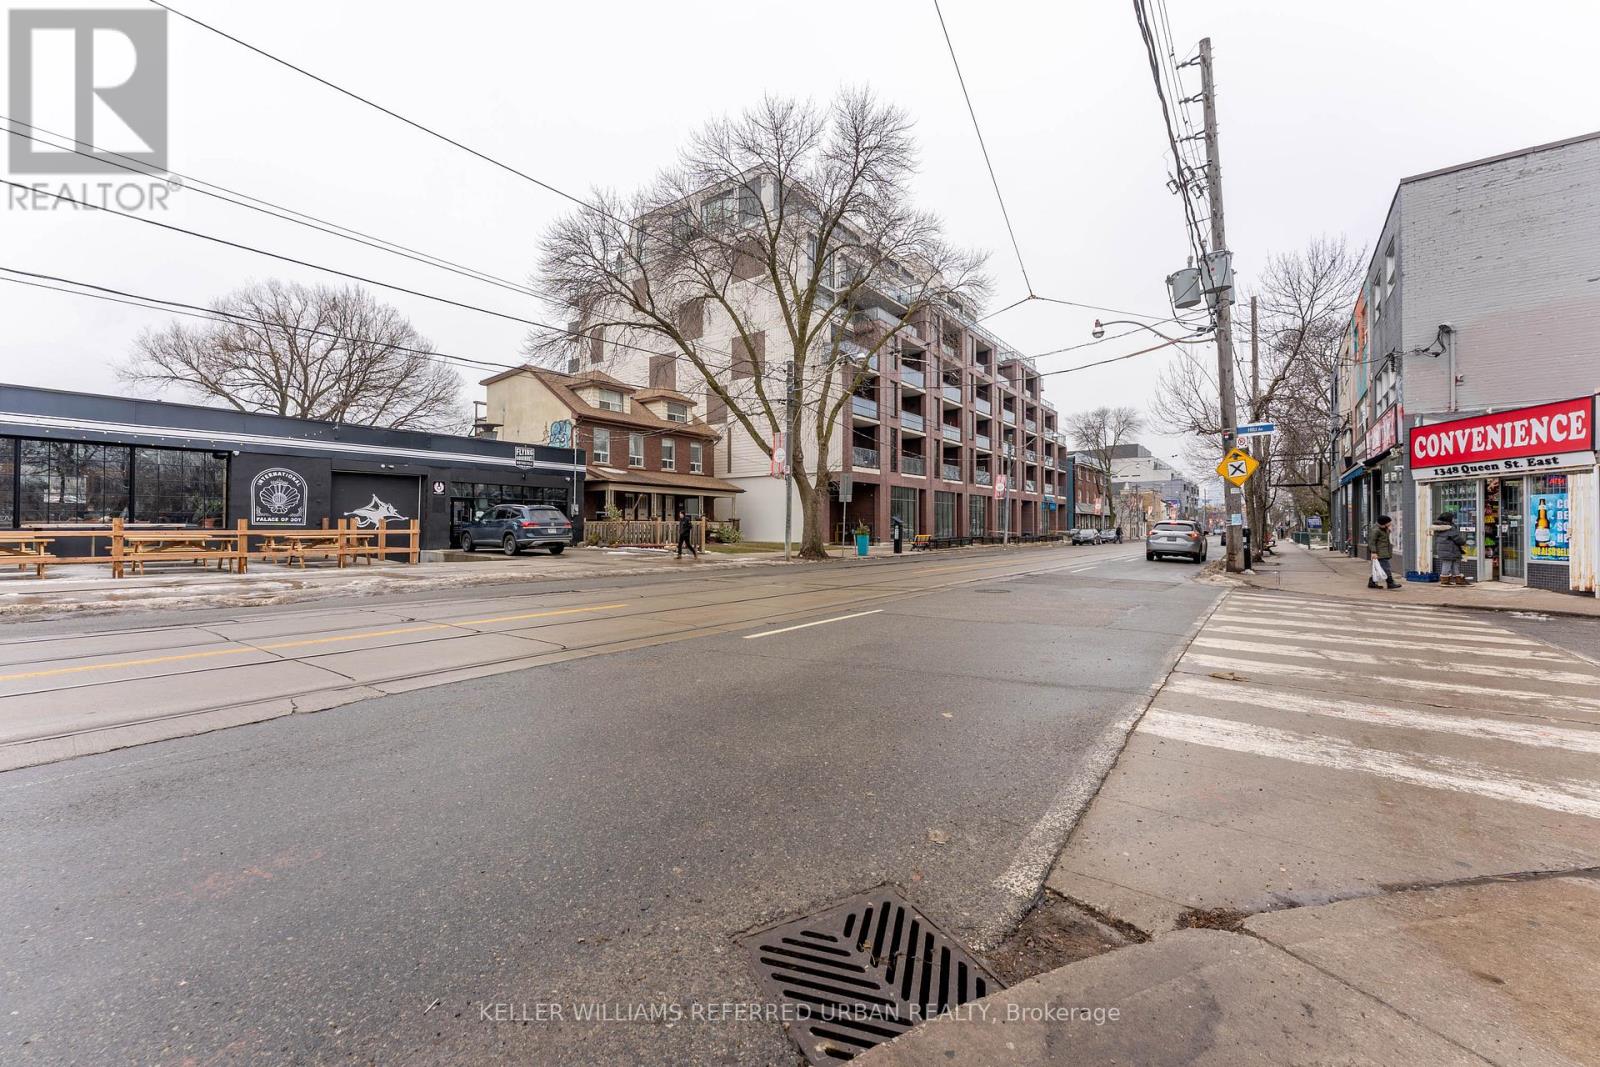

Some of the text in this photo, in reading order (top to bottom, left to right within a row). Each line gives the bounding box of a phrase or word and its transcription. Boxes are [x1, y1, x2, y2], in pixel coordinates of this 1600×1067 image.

[1414, 410, 1587, 459] CONVENIENCE
[1434, 456, 1559, 476] 1348 Queen St. East
[257, 471, 302, 487] INTERNATIONAL
